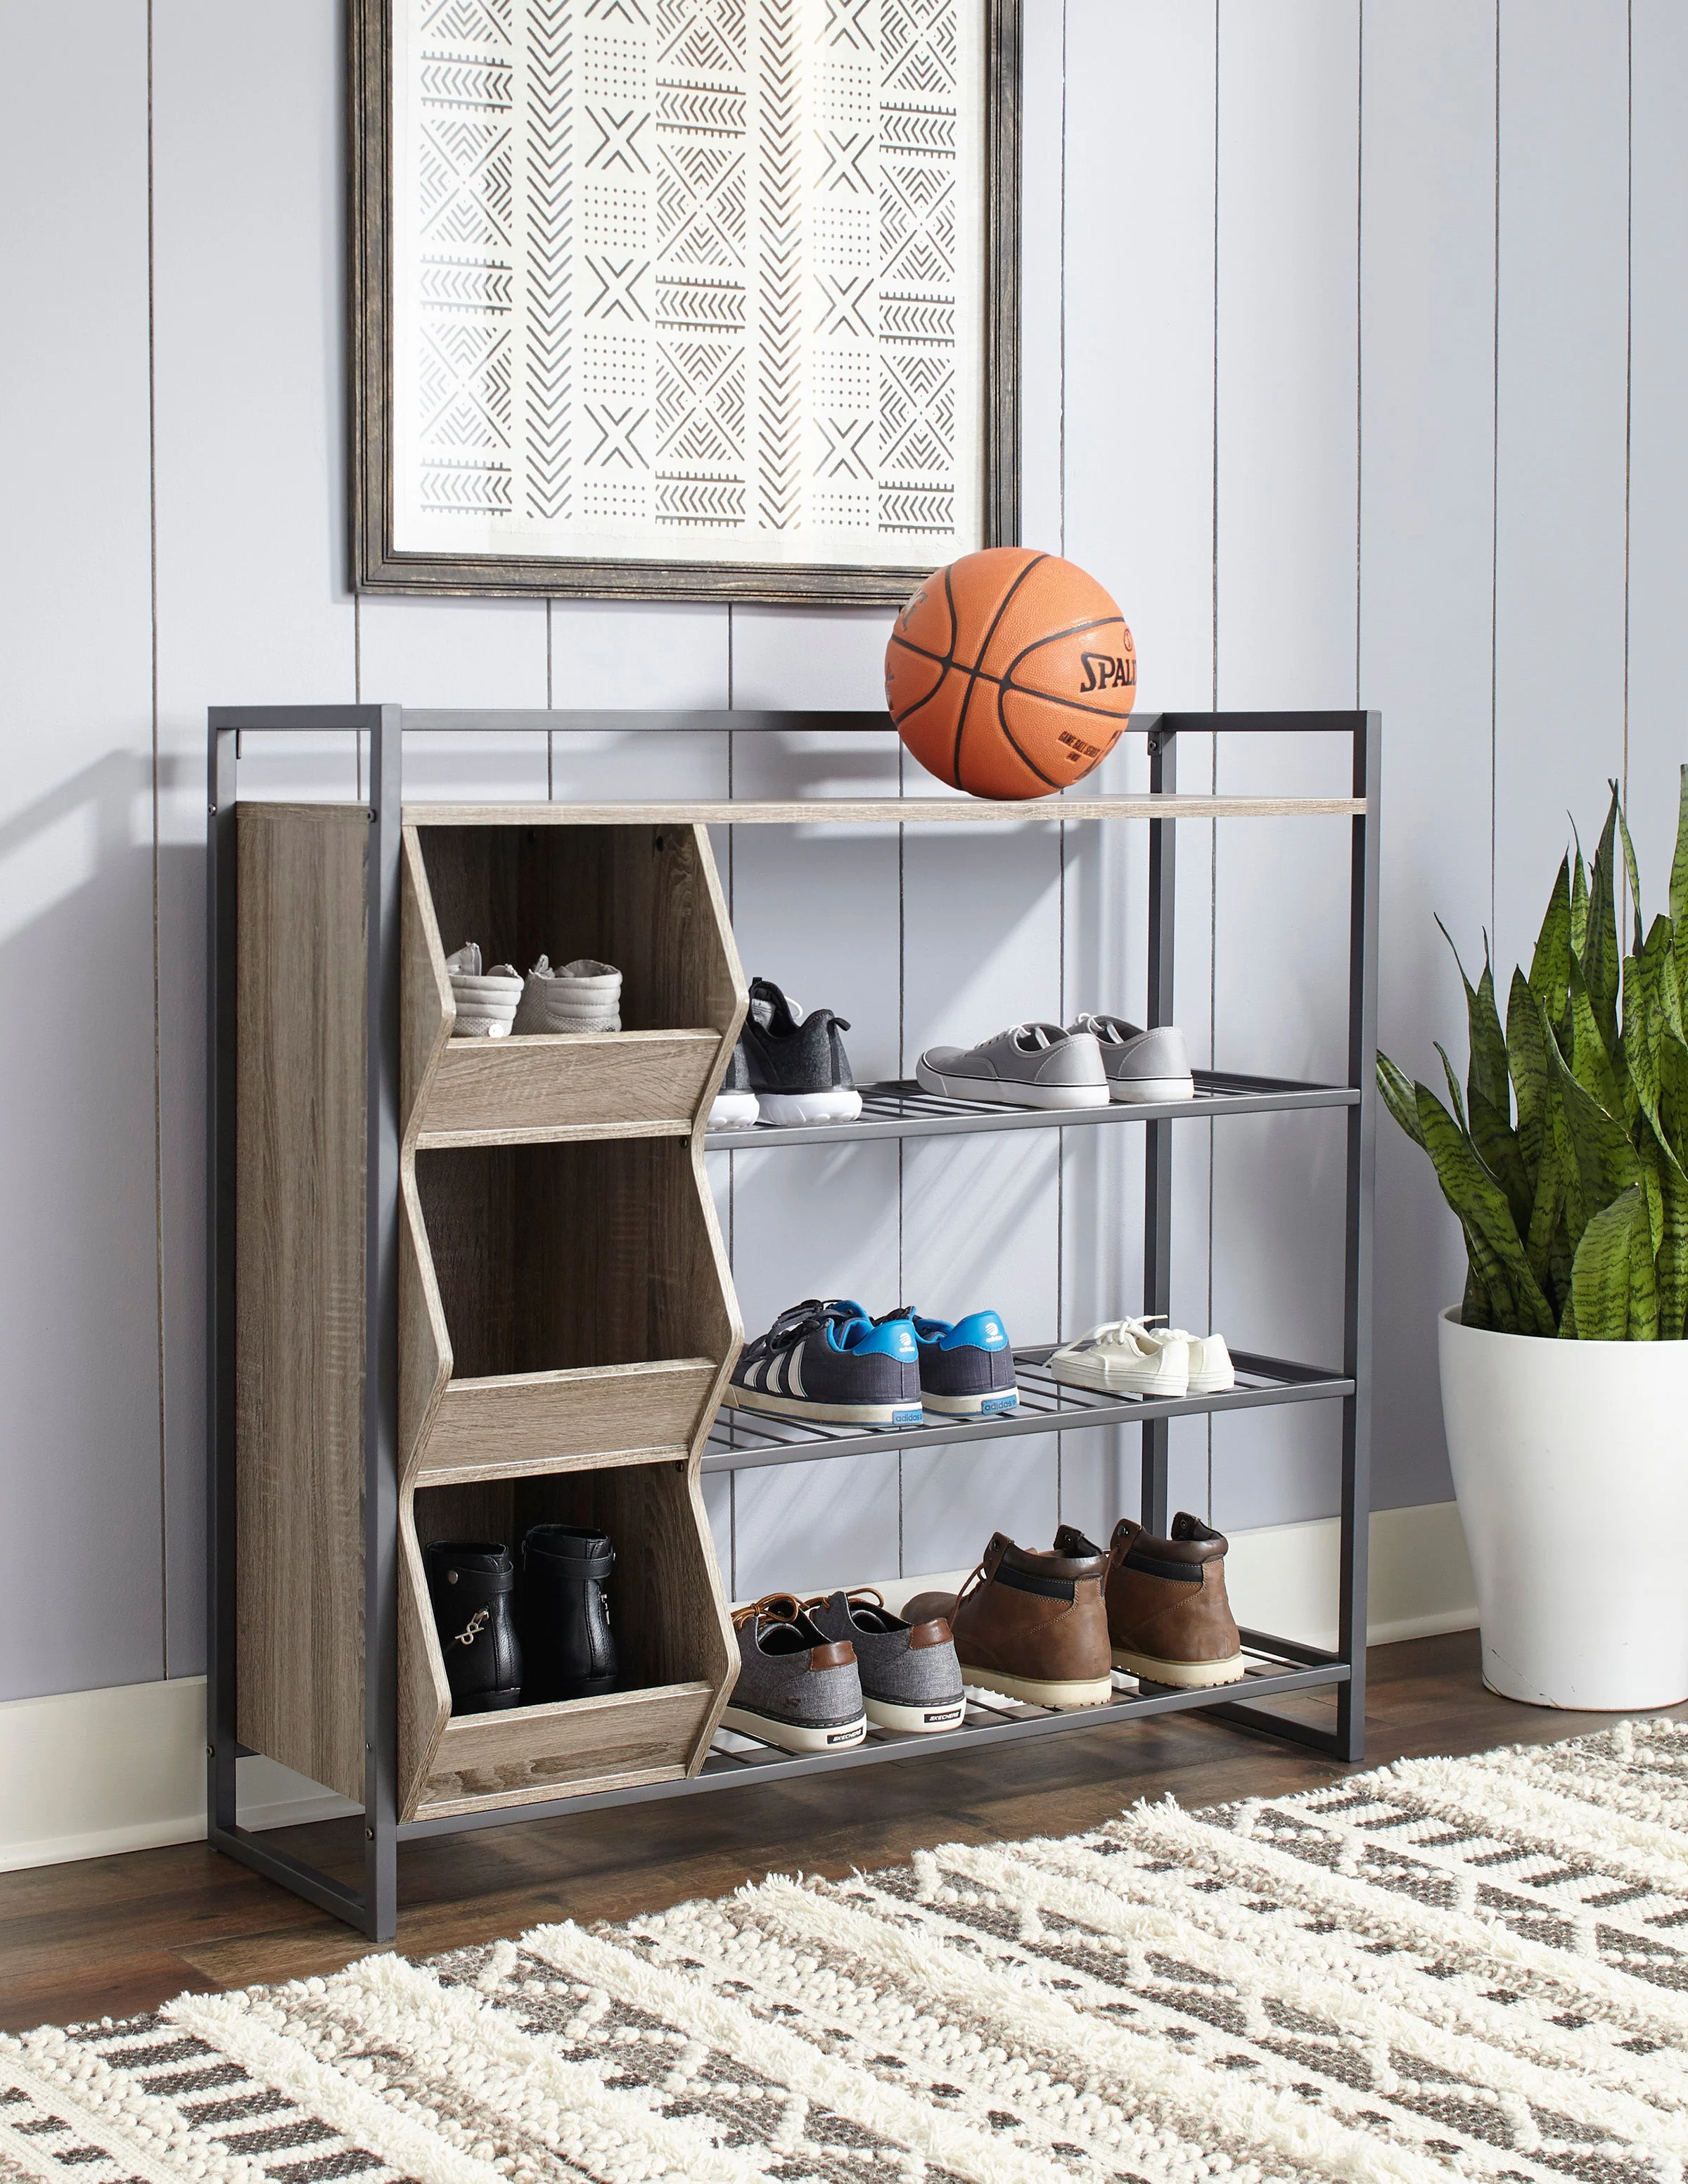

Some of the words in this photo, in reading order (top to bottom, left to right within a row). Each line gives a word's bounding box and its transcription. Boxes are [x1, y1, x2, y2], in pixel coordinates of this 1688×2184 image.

[1058, 731, 1077, 746] GAME
[1072, 739, 1087, 753] BALL
[985, 1400, 1012, 1411] adidas
[895, 1412, 919, 1422] adidas
[929, 1711, 959, 1721] SKECHERS
[833, 1729, 862, 1742] SKECHERS
